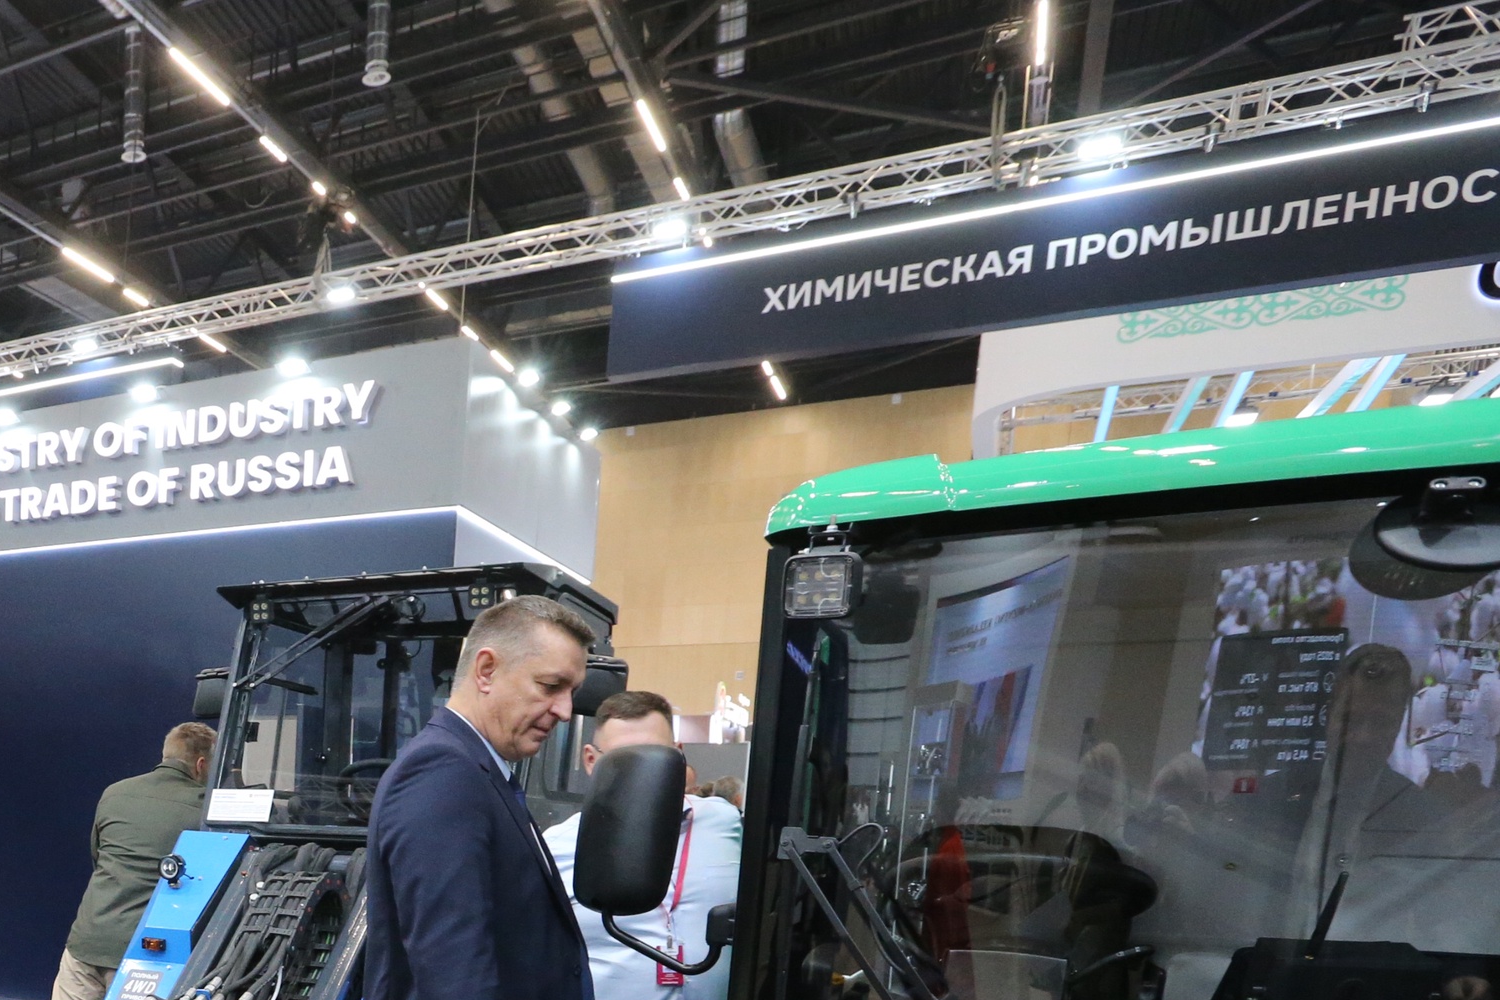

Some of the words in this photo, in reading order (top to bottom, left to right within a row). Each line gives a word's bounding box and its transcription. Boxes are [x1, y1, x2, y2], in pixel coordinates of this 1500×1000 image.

[762, 245, 1033, 316] ХИМИЧЕСКАЯ
[93, 420, 148, 458] OF
[154, 379, 379, 451] INDUSTRY
[0, 475, 121, 524] TRADE
[126, 467, 181, 507] OF
[190, 445, 353, 500] RUSSIA
[124, 980, 156, 994] 4WD
[131, 972, 159, 980] ПОЛНЫЙ
